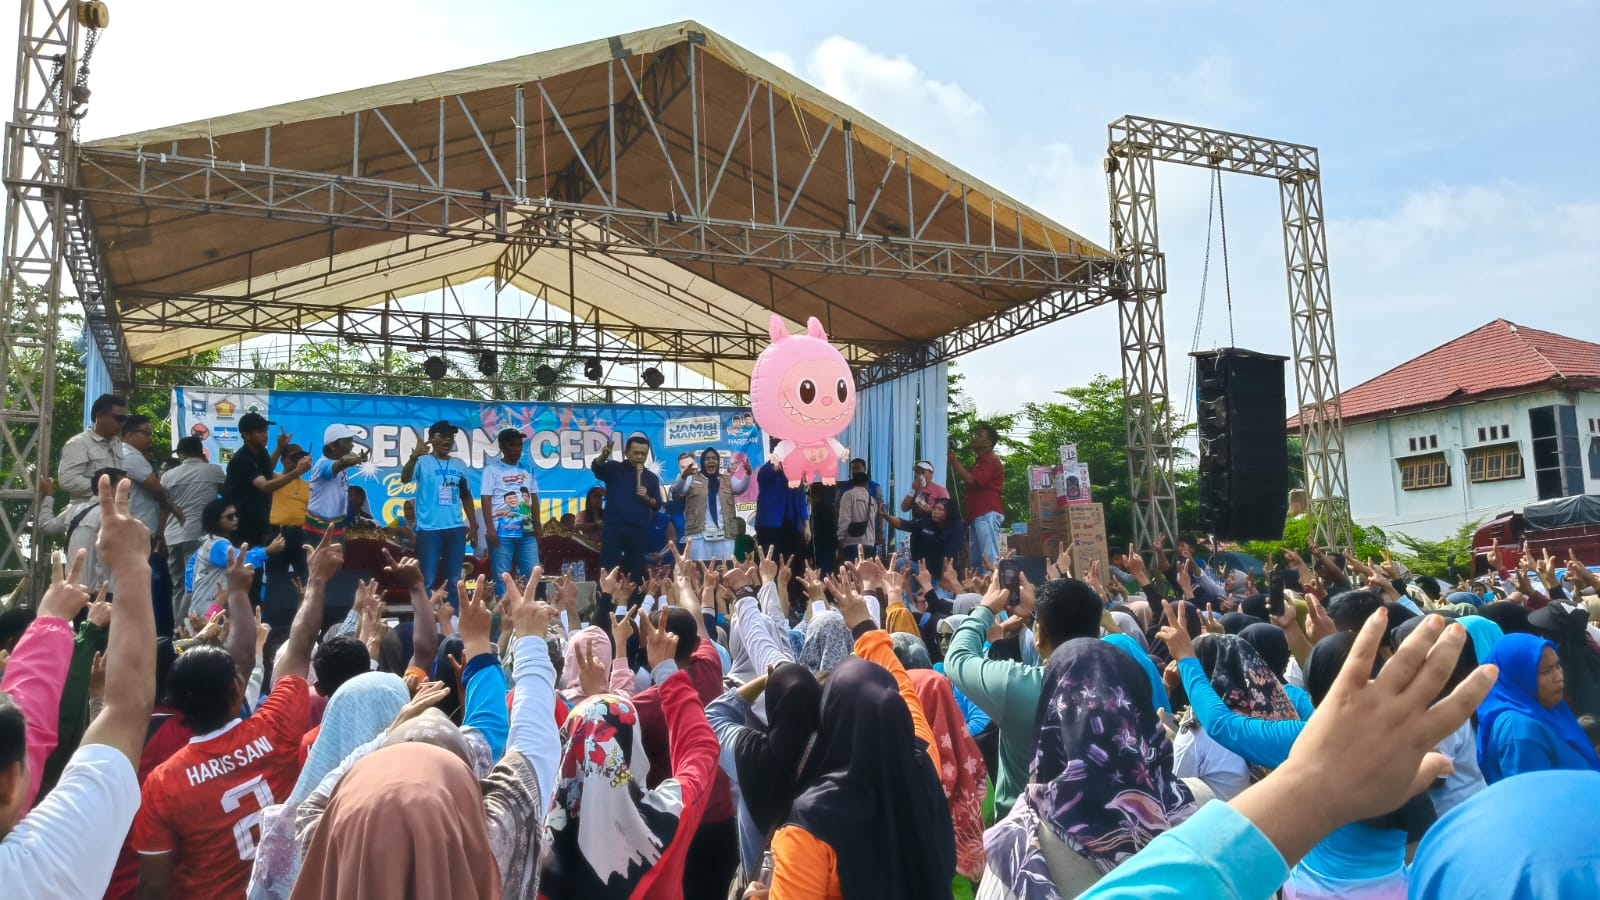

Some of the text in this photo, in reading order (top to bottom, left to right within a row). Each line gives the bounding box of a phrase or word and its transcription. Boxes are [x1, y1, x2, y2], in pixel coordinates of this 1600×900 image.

[669, 423, 717, 433] JAMBI
[669, 430, 718, 440] MANTAP
[186, 735, 274, 787] HARIS SANI
[220, 773, 275, 861] 2
